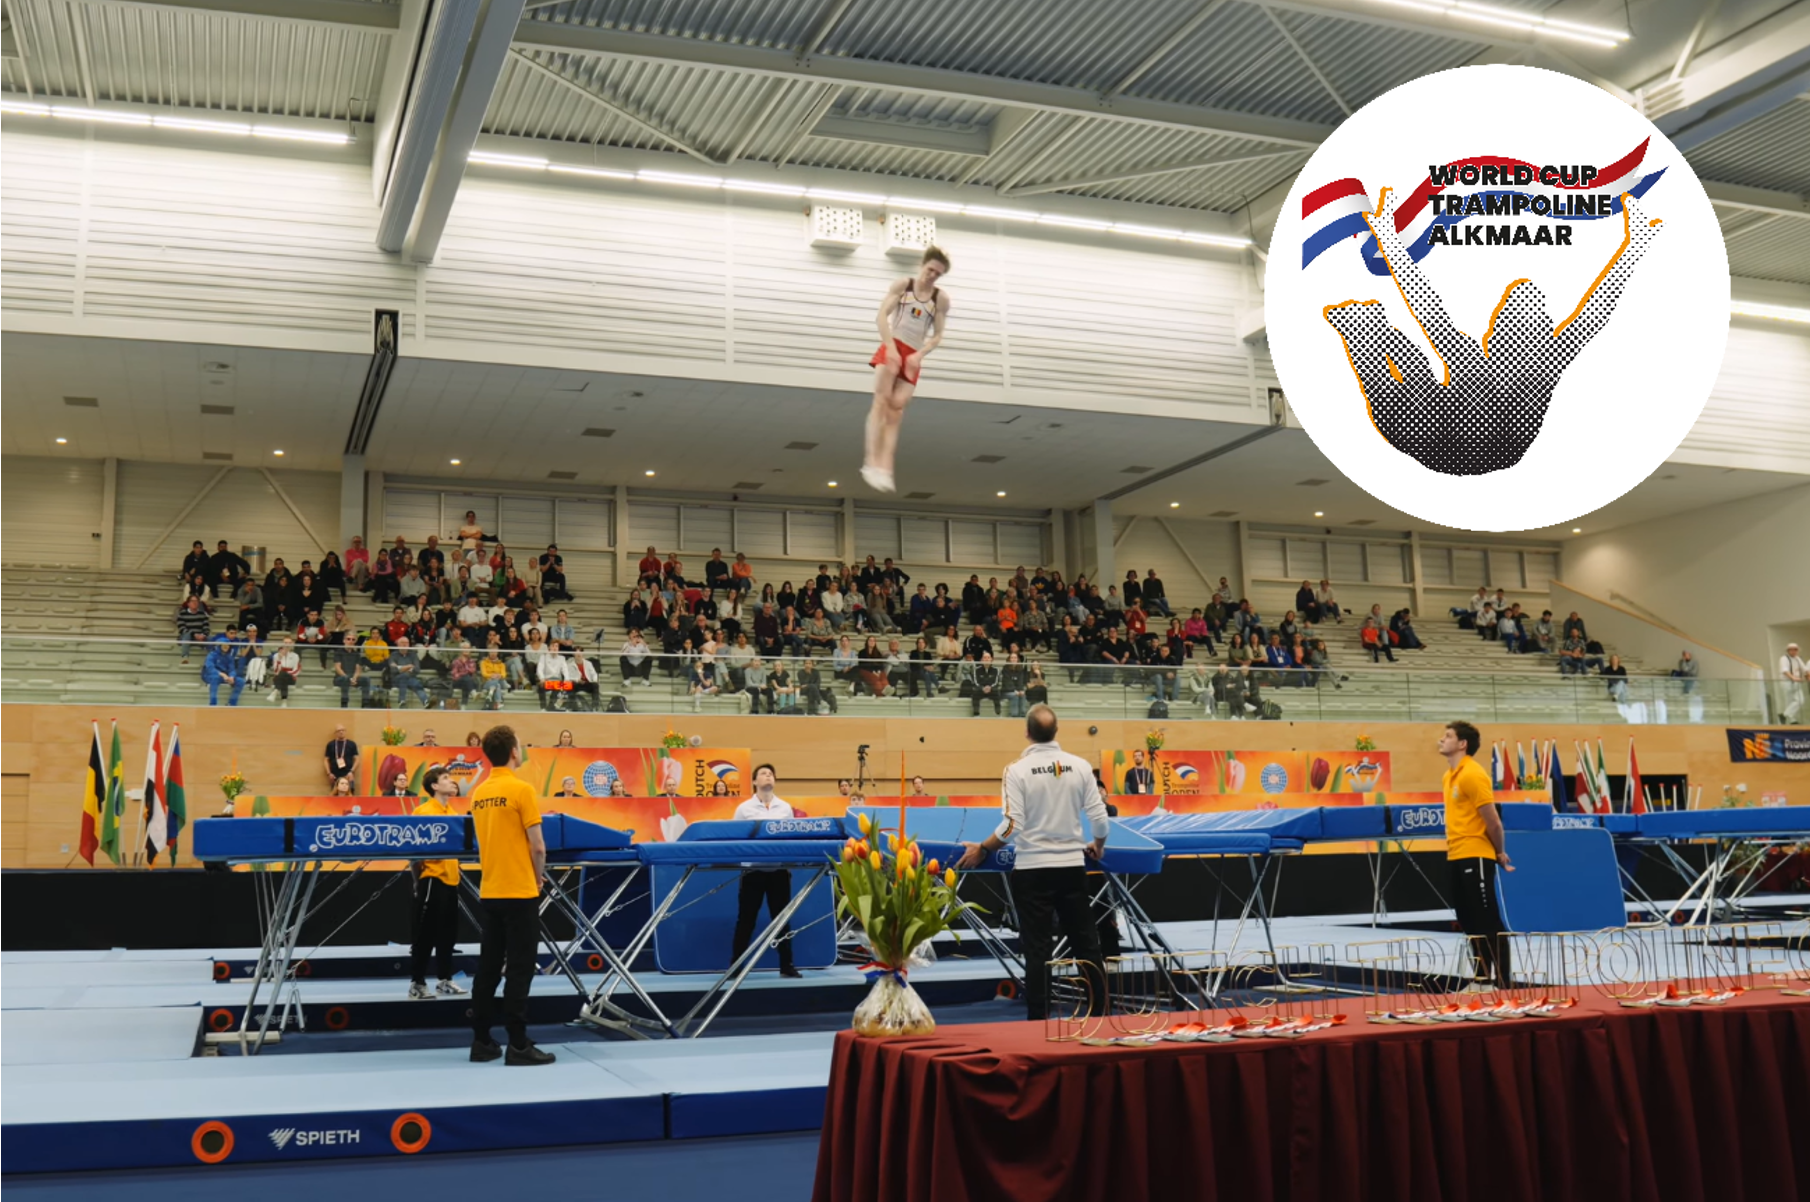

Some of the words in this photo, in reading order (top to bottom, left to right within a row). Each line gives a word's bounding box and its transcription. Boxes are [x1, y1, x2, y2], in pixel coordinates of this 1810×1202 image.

[472, 797, 507, 811] POTTER
[314, 822, 449, 849] EUROTRAMP
[295, 1129, 361, 1146] SPIETH
